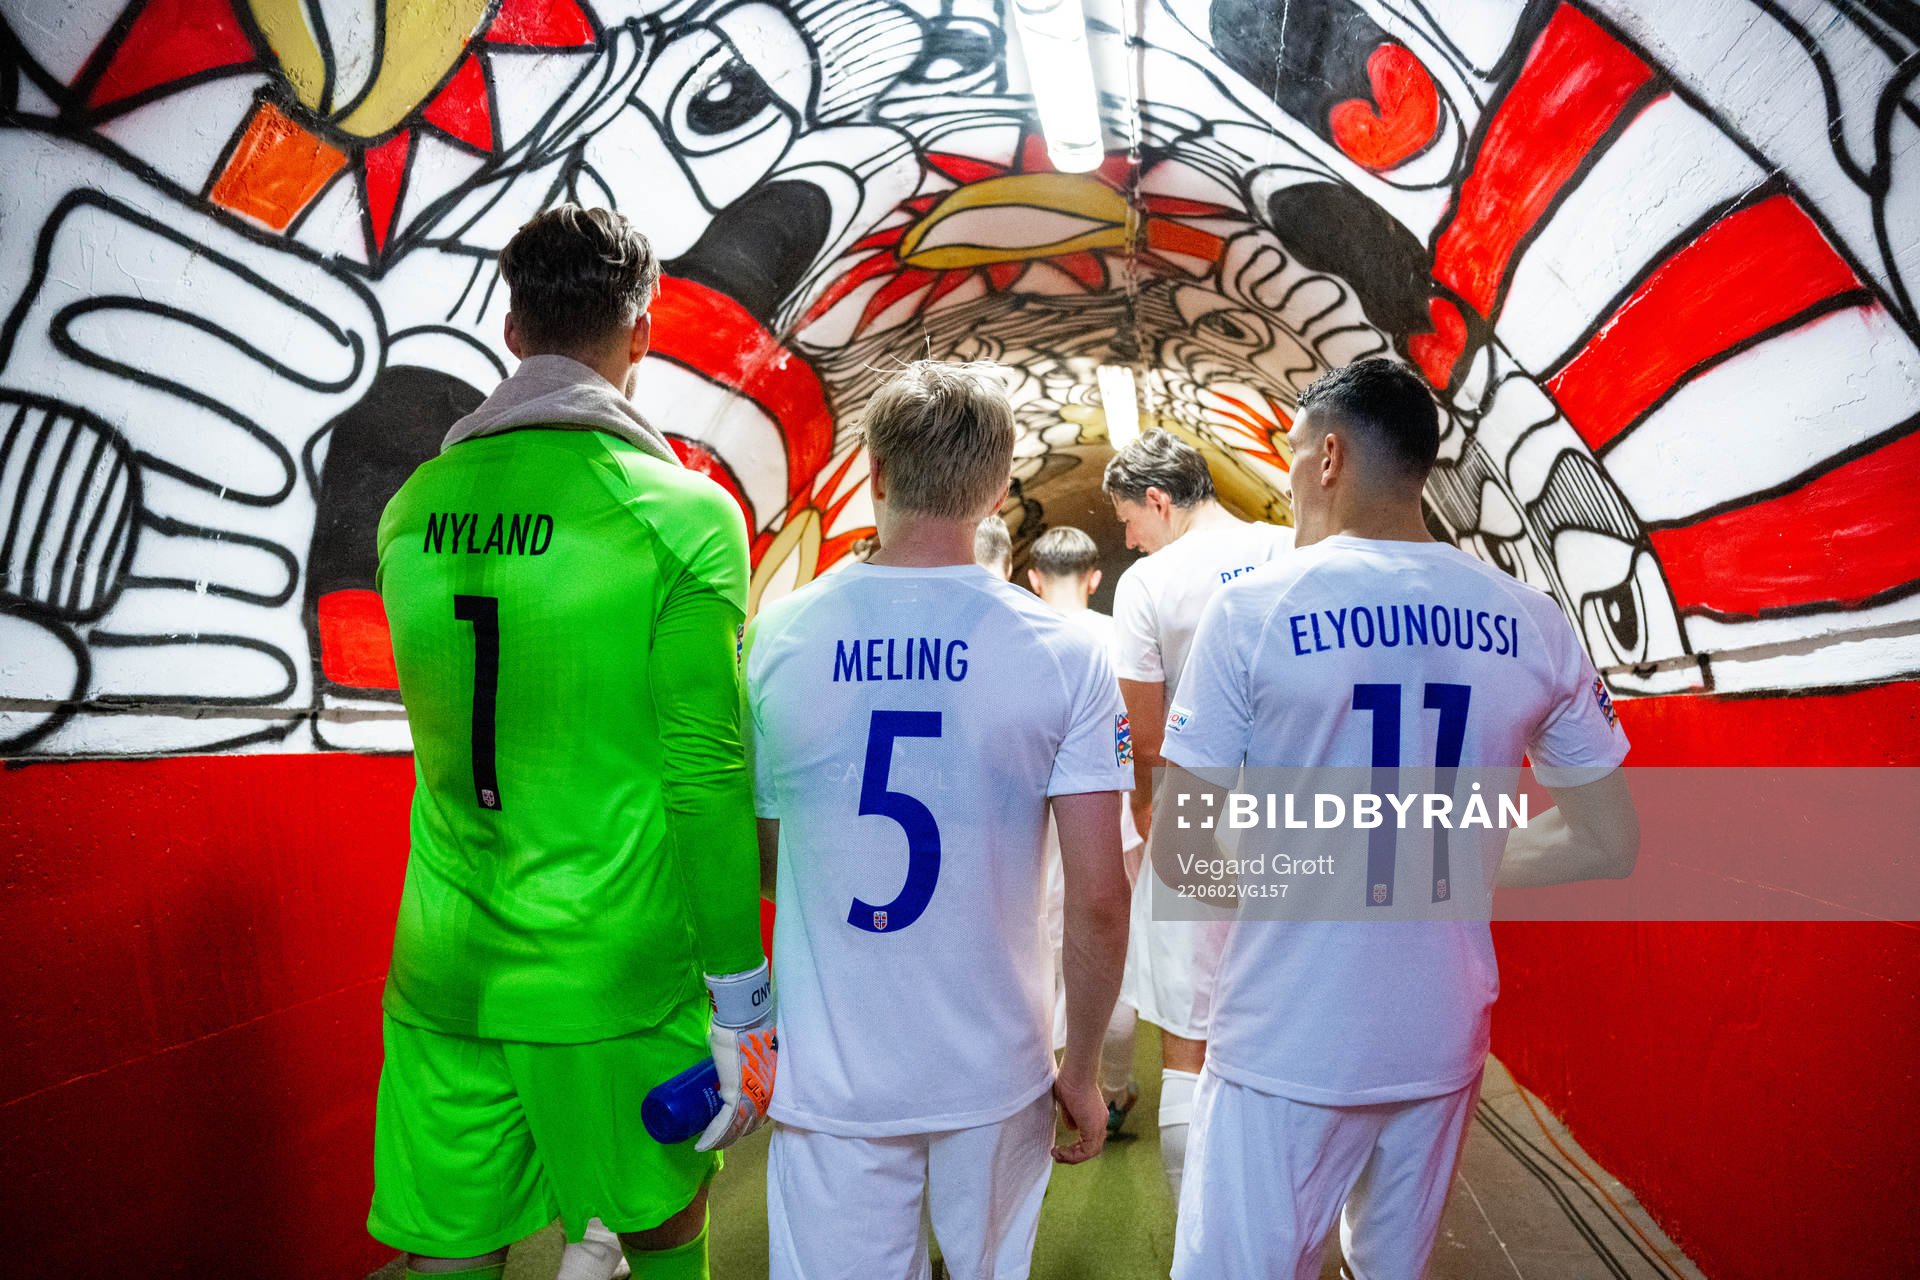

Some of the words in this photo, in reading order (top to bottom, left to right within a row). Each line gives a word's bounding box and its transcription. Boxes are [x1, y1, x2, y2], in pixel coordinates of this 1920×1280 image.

[423, 512, 554, 556] NYLAND
[832, 637, 969, 682] MELING
[1289, 604, 1519, 658] ELYOUNOUSSI
[453, 594, 502, 812] 1
[846, 709, 942, 934] 5
[1351, 682, 1471, 907] 11
